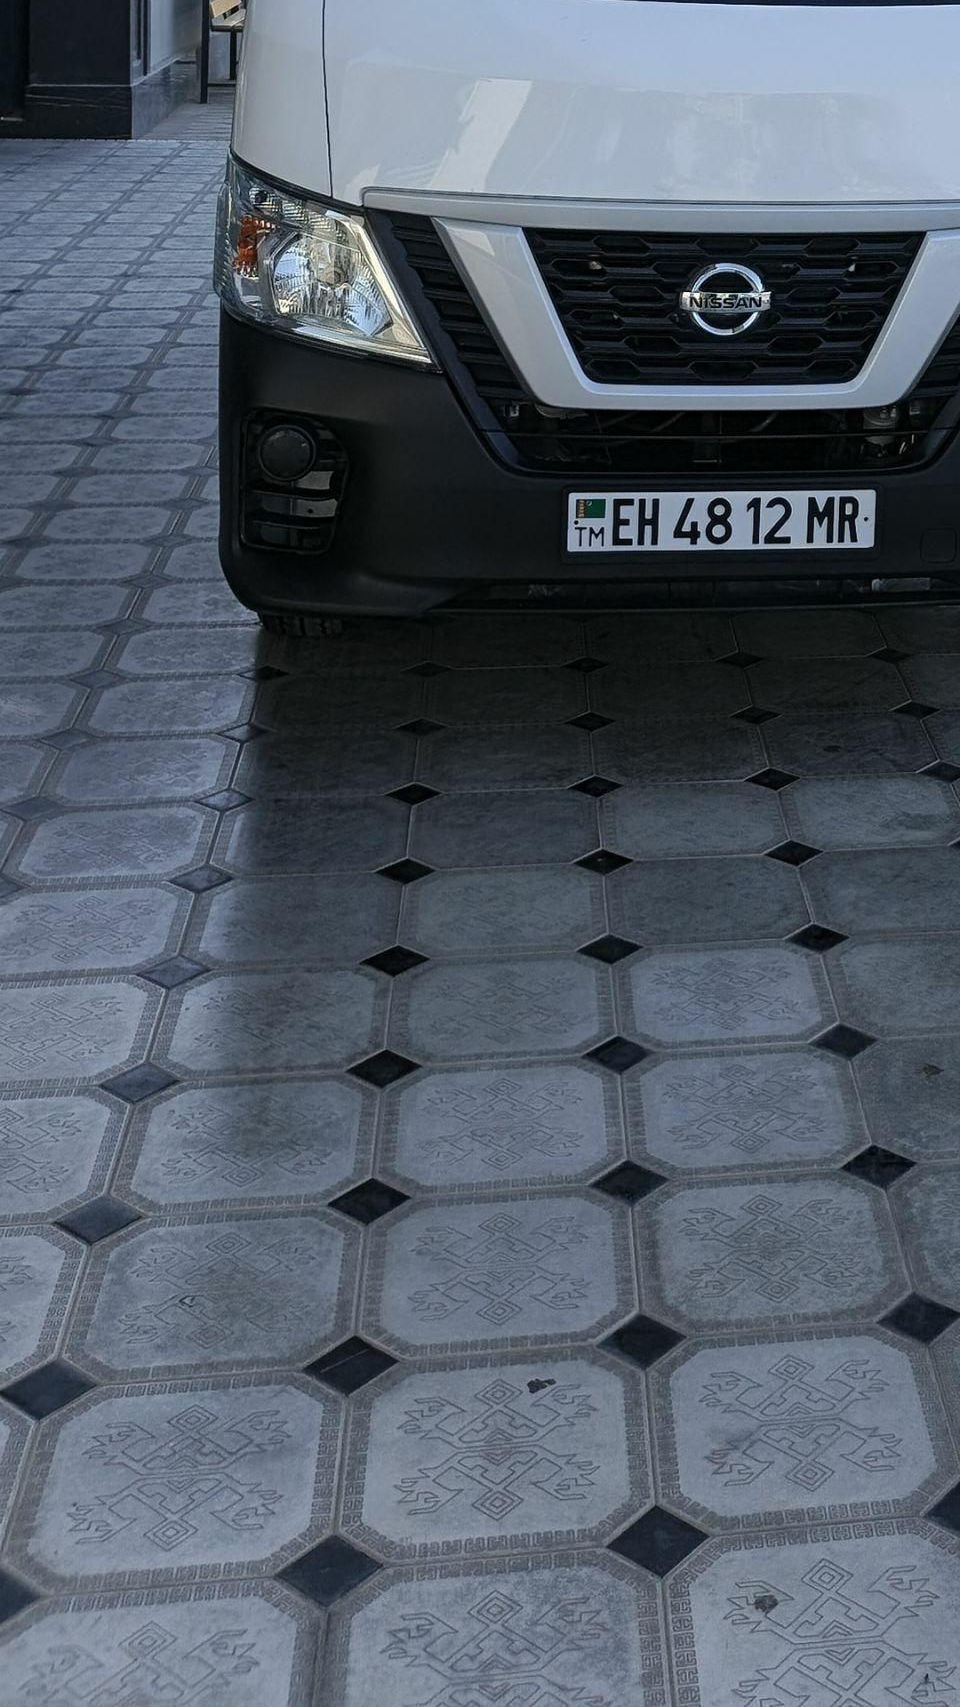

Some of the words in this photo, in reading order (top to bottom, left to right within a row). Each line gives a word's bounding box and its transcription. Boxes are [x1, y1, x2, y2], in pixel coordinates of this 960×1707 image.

[689, 296, 762, 309] NISSAN
[611, 498, 660, 546] EH
[806, 496, 860, 544] MR
[574, 527, 605, 547] TM
